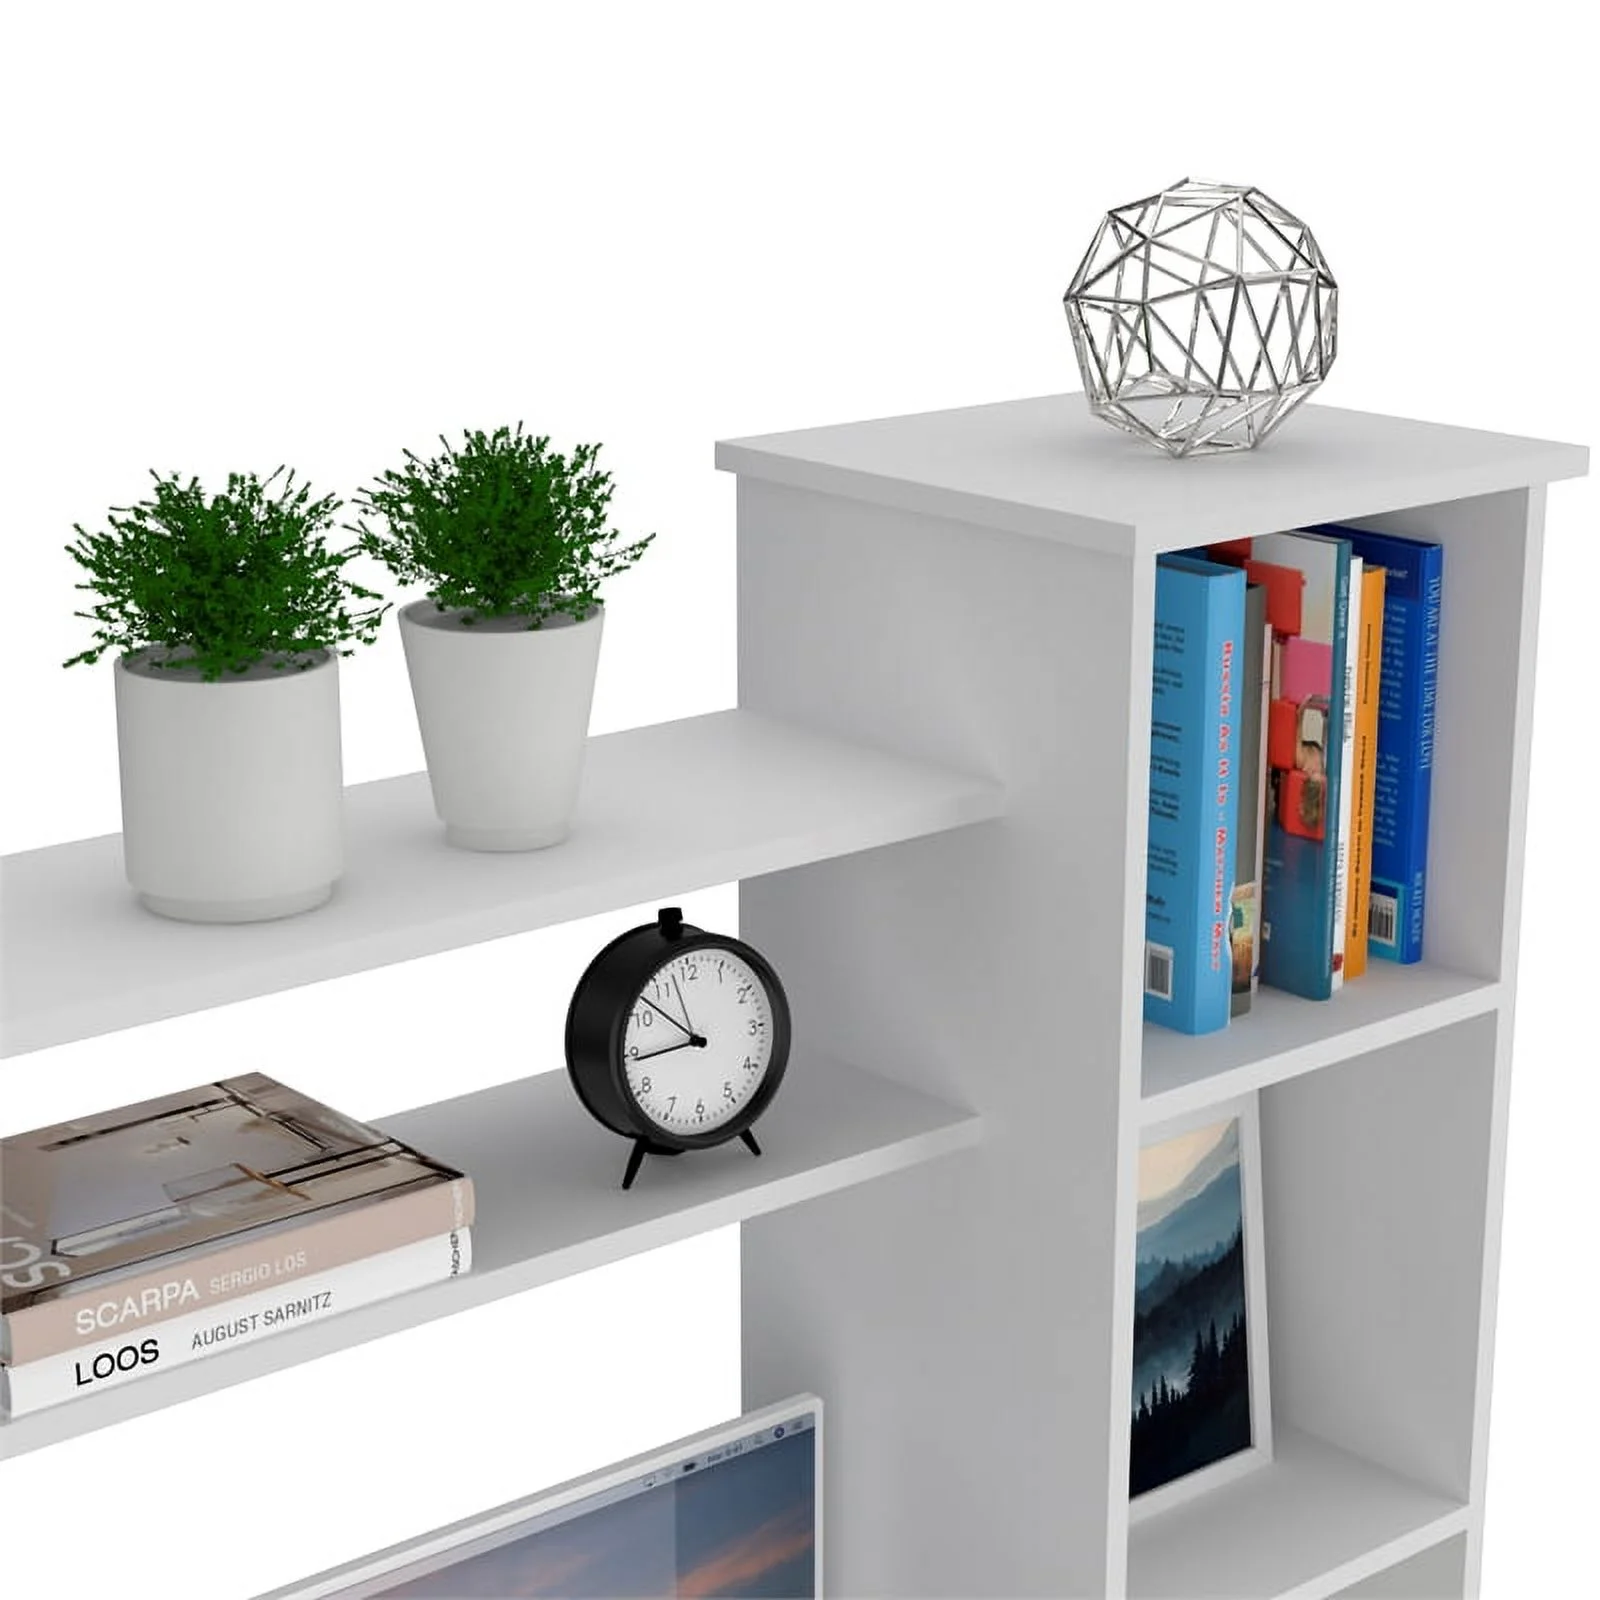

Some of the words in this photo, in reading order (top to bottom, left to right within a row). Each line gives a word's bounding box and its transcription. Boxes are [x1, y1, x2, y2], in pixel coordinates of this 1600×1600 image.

[681, 964, 698, 982] 12
[654, 979, 670, 1000] 11
[737, 987, 748, 1004] 2
[632, 1010, 653, 1029] 10
[748, 1019, 758, 1036] 3
[742, 1056, 752, 1070] 4
[641, 1076, 652, 1093] 8
[723, 1082, 733, 1099] 5
[667, 1096, 678, 1113] 7
[695, 1098, 705, 1115] 6
[76, 1279, 201, 1335] SCARPA
[209, 1261, 271, 1296] SERGIO
[274, 1250, 308, 1277] LOS
[75, 1338, 160, 1387] LOOS
[191, 1314, 260, 1351] AUGUST
[263, 1290, 332, 1328] SARNITZ
